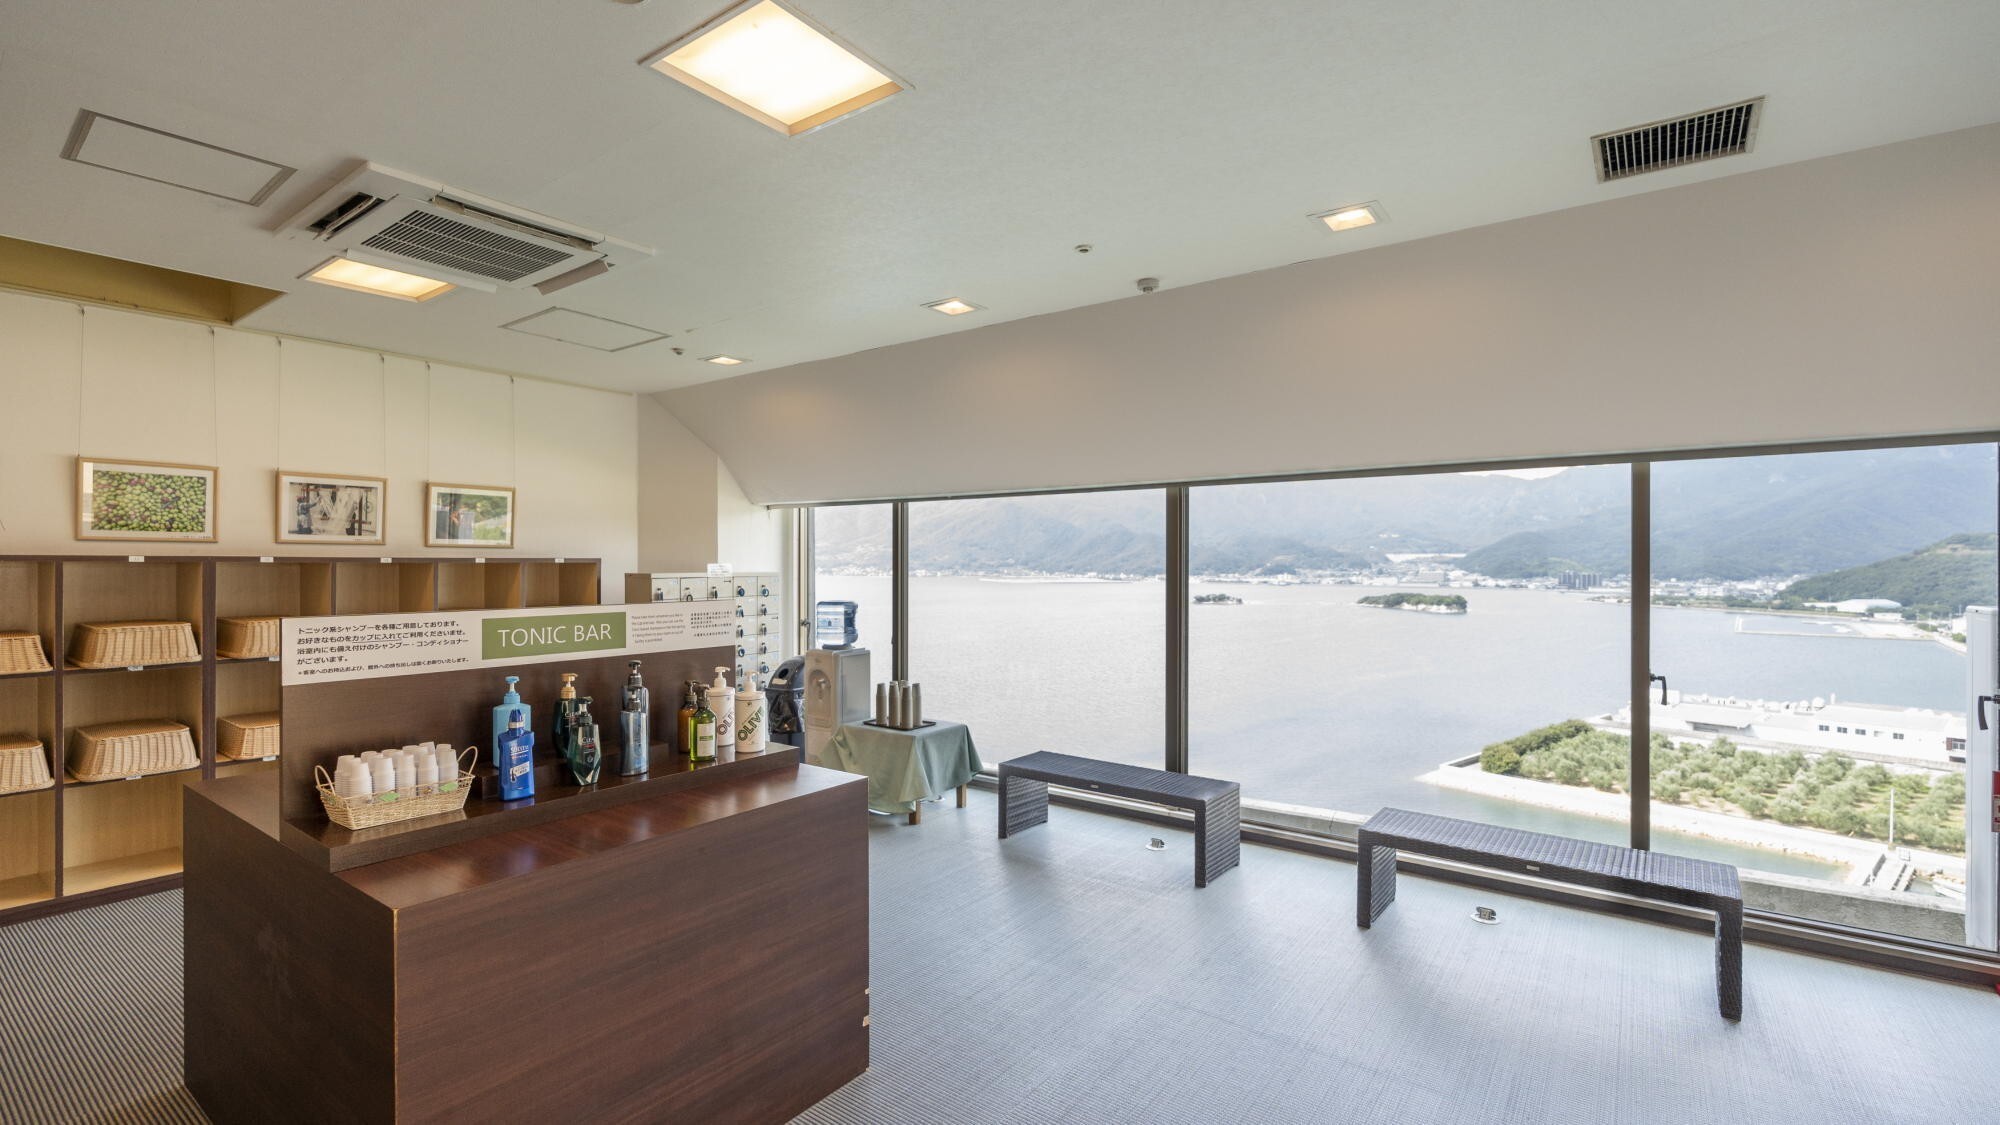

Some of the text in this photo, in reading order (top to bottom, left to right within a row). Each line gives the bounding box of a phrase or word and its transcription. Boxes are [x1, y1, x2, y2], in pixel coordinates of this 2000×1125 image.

[497, 623, 613, 648] TONIC BAR
[296, 655, 349, 666] がございます。
[718, 711, 735, 736] OLI
